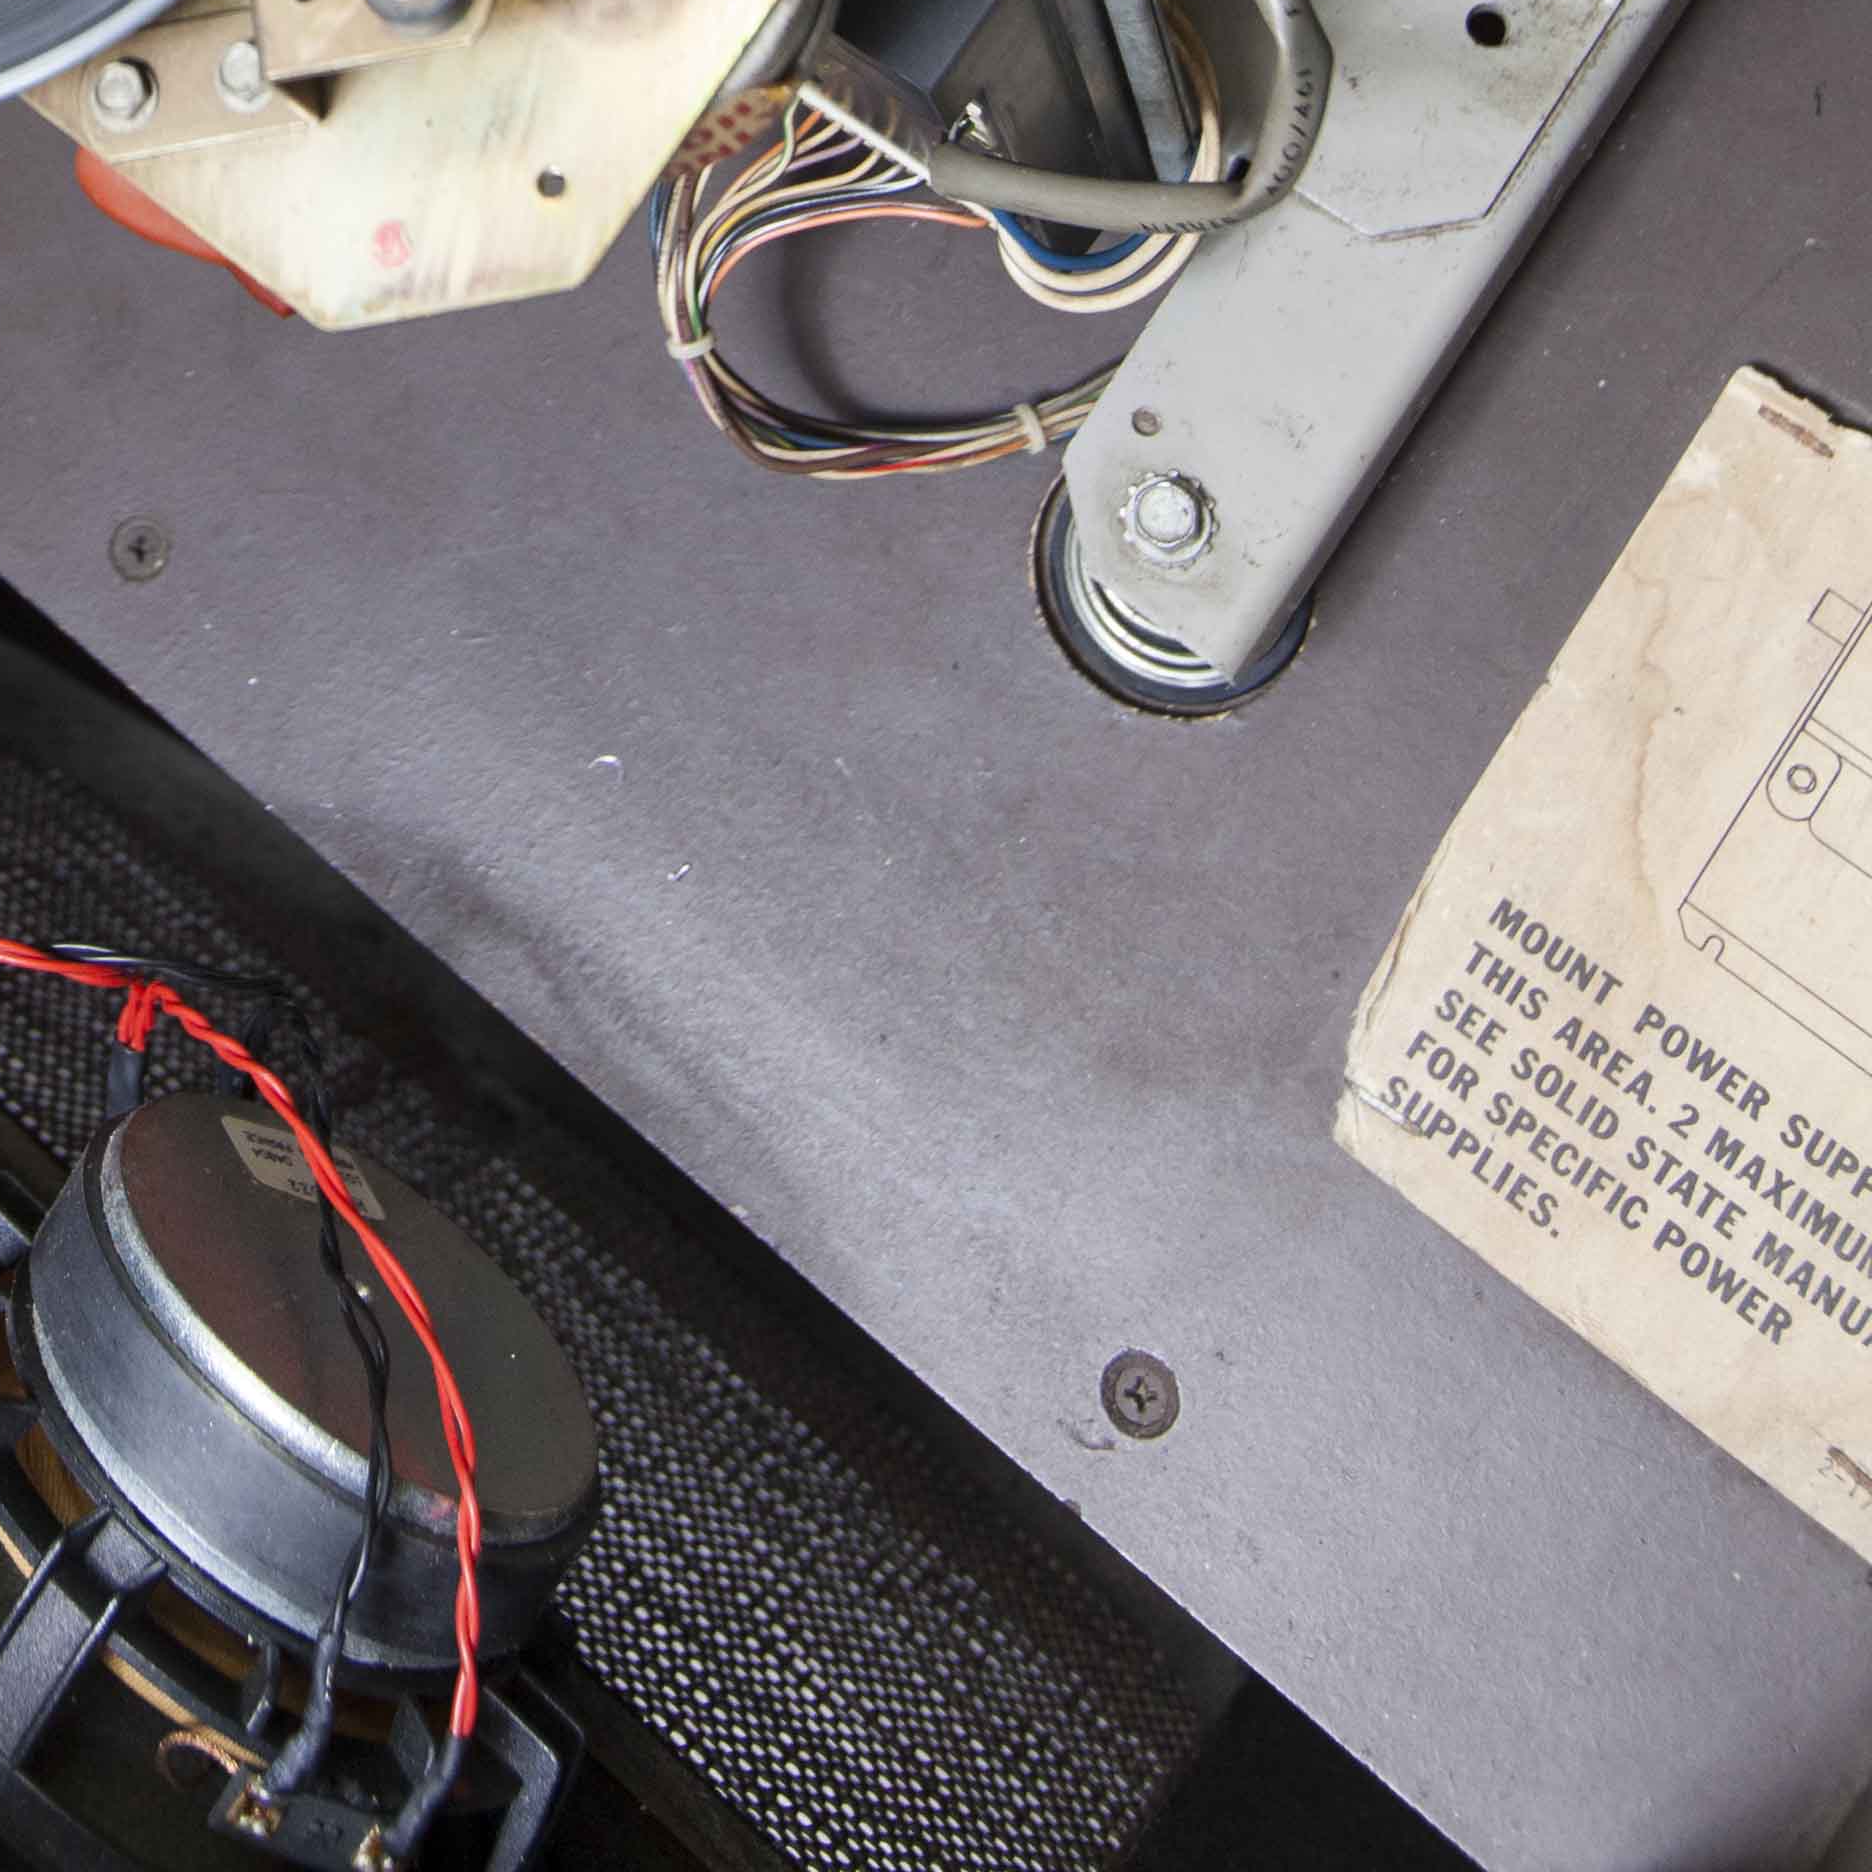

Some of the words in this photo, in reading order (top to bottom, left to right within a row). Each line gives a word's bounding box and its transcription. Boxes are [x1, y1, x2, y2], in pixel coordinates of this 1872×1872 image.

[1435, 988, 1508, 1056] SEE
[1510, 1047, 1620, 1141] SOLID
[1627, 1135, 1748, 1241] STATE
[1463, 940, 1550, 1021] THIS
[1552, 1016, 1658, 1115] AREA.
[1669, 1103, 1701, 1140] 2
[1489, 897, 1624, 1006] MOUNT
[1633, 1004, 1771, 1121] POWER
[1380, 1075, 1561, 1238] SUPPLIES.
[1405, 1030, 1480, 1101] FOR
[1484, 1091, 1649, 1231] SPECIFIC
[1652, 1219, 1794, 1346] POWER
